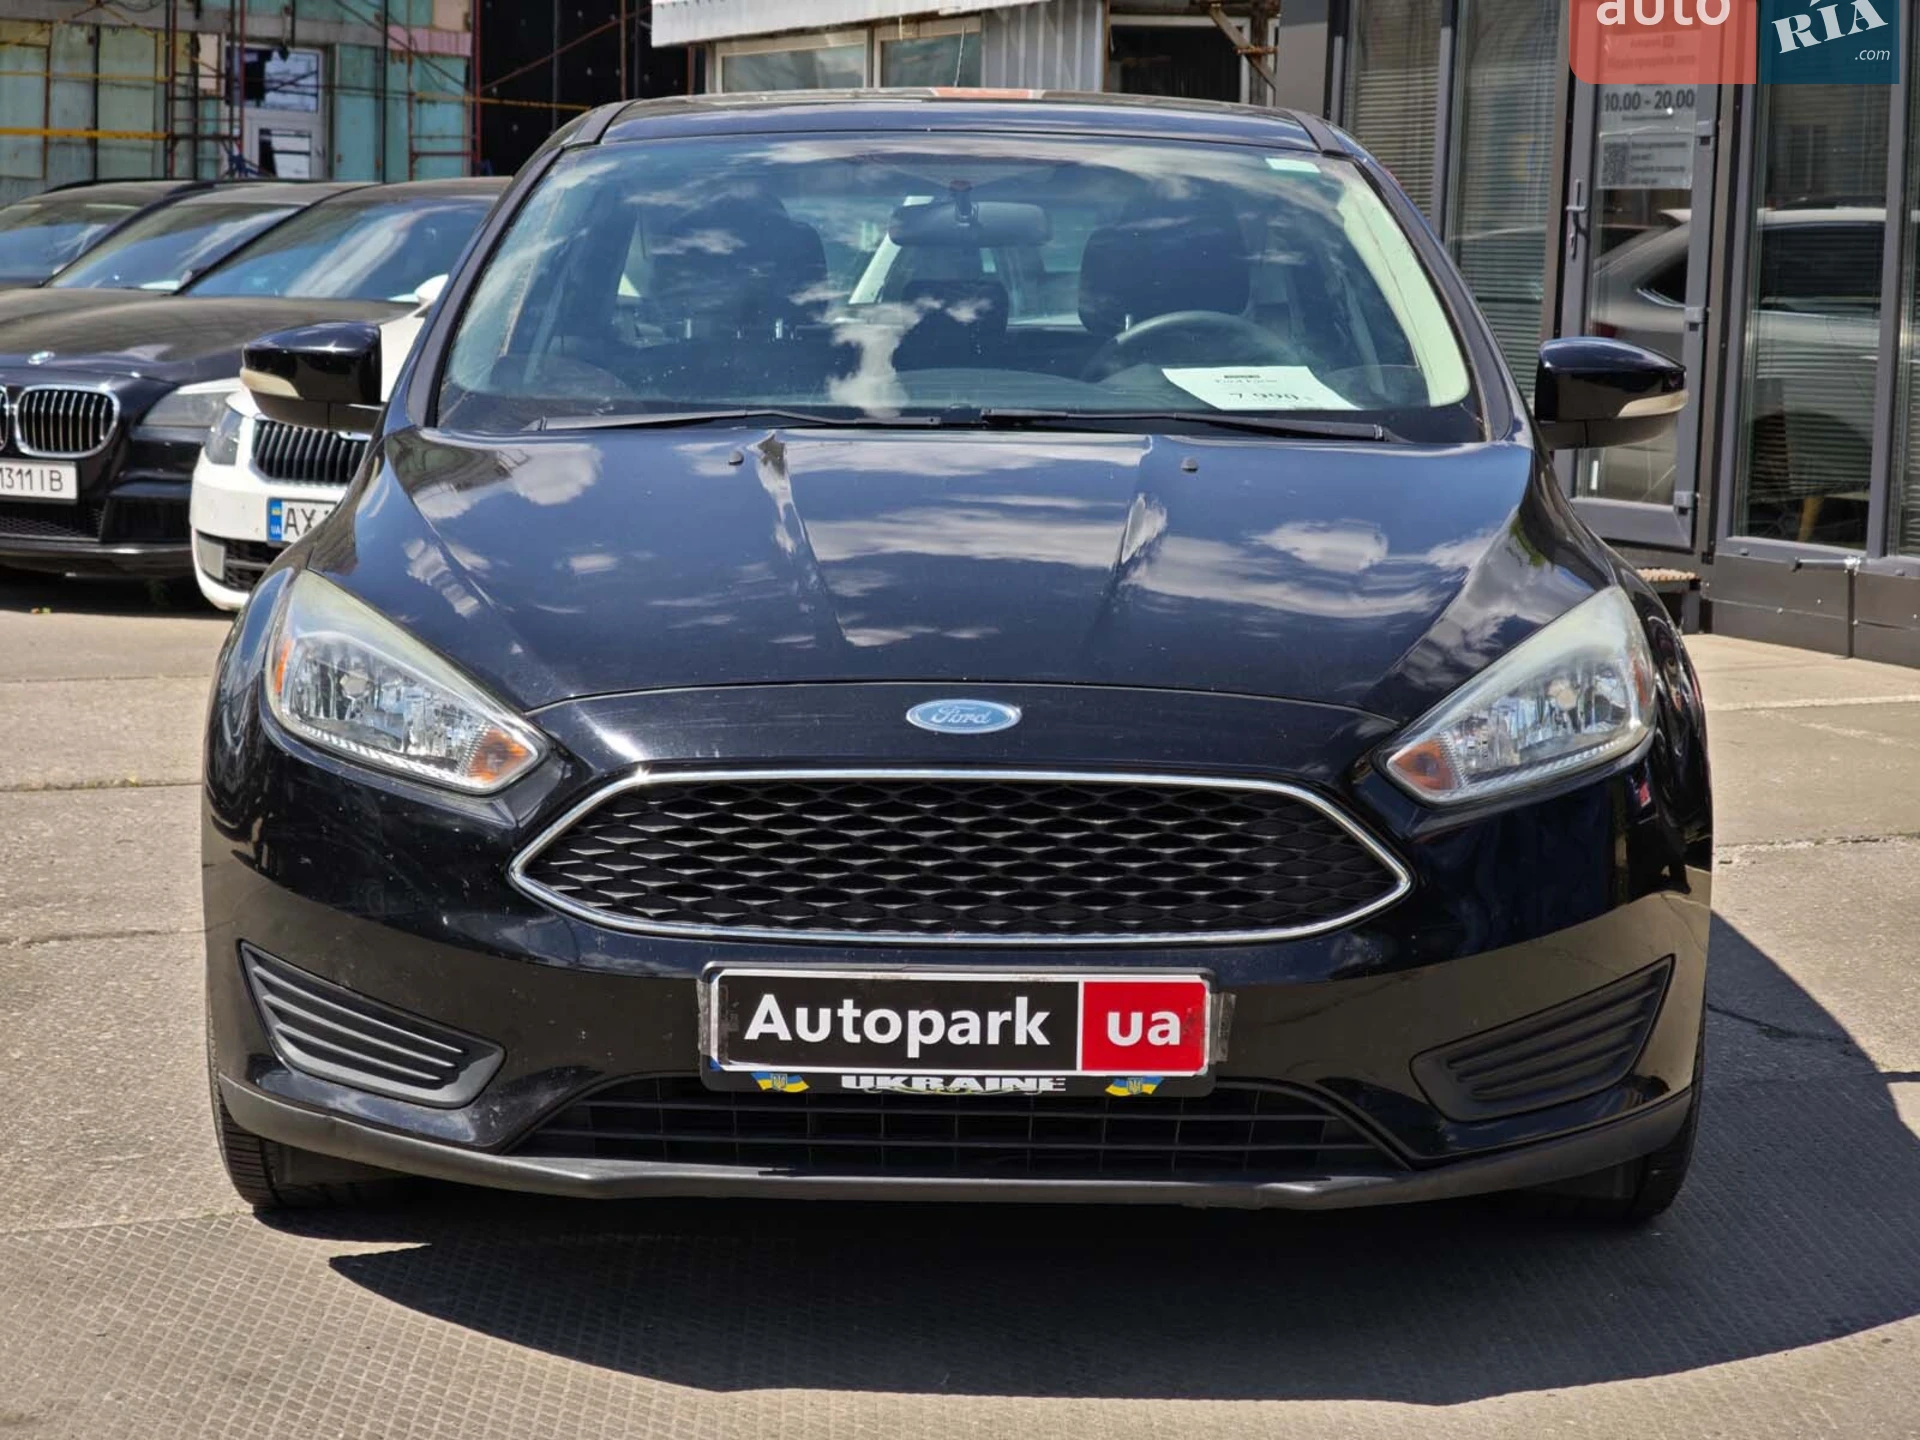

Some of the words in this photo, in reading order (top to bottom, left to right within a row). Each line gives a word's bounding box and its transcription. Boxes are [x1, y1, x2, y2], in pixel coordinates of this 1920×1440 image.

[931, 704, 992, 724] Ford
[744, 993, 1052, 1059] Autopark
[1106, 1009, 1183, 1046] ua
[841, 1075, 1067, 1093] UKRAINE
